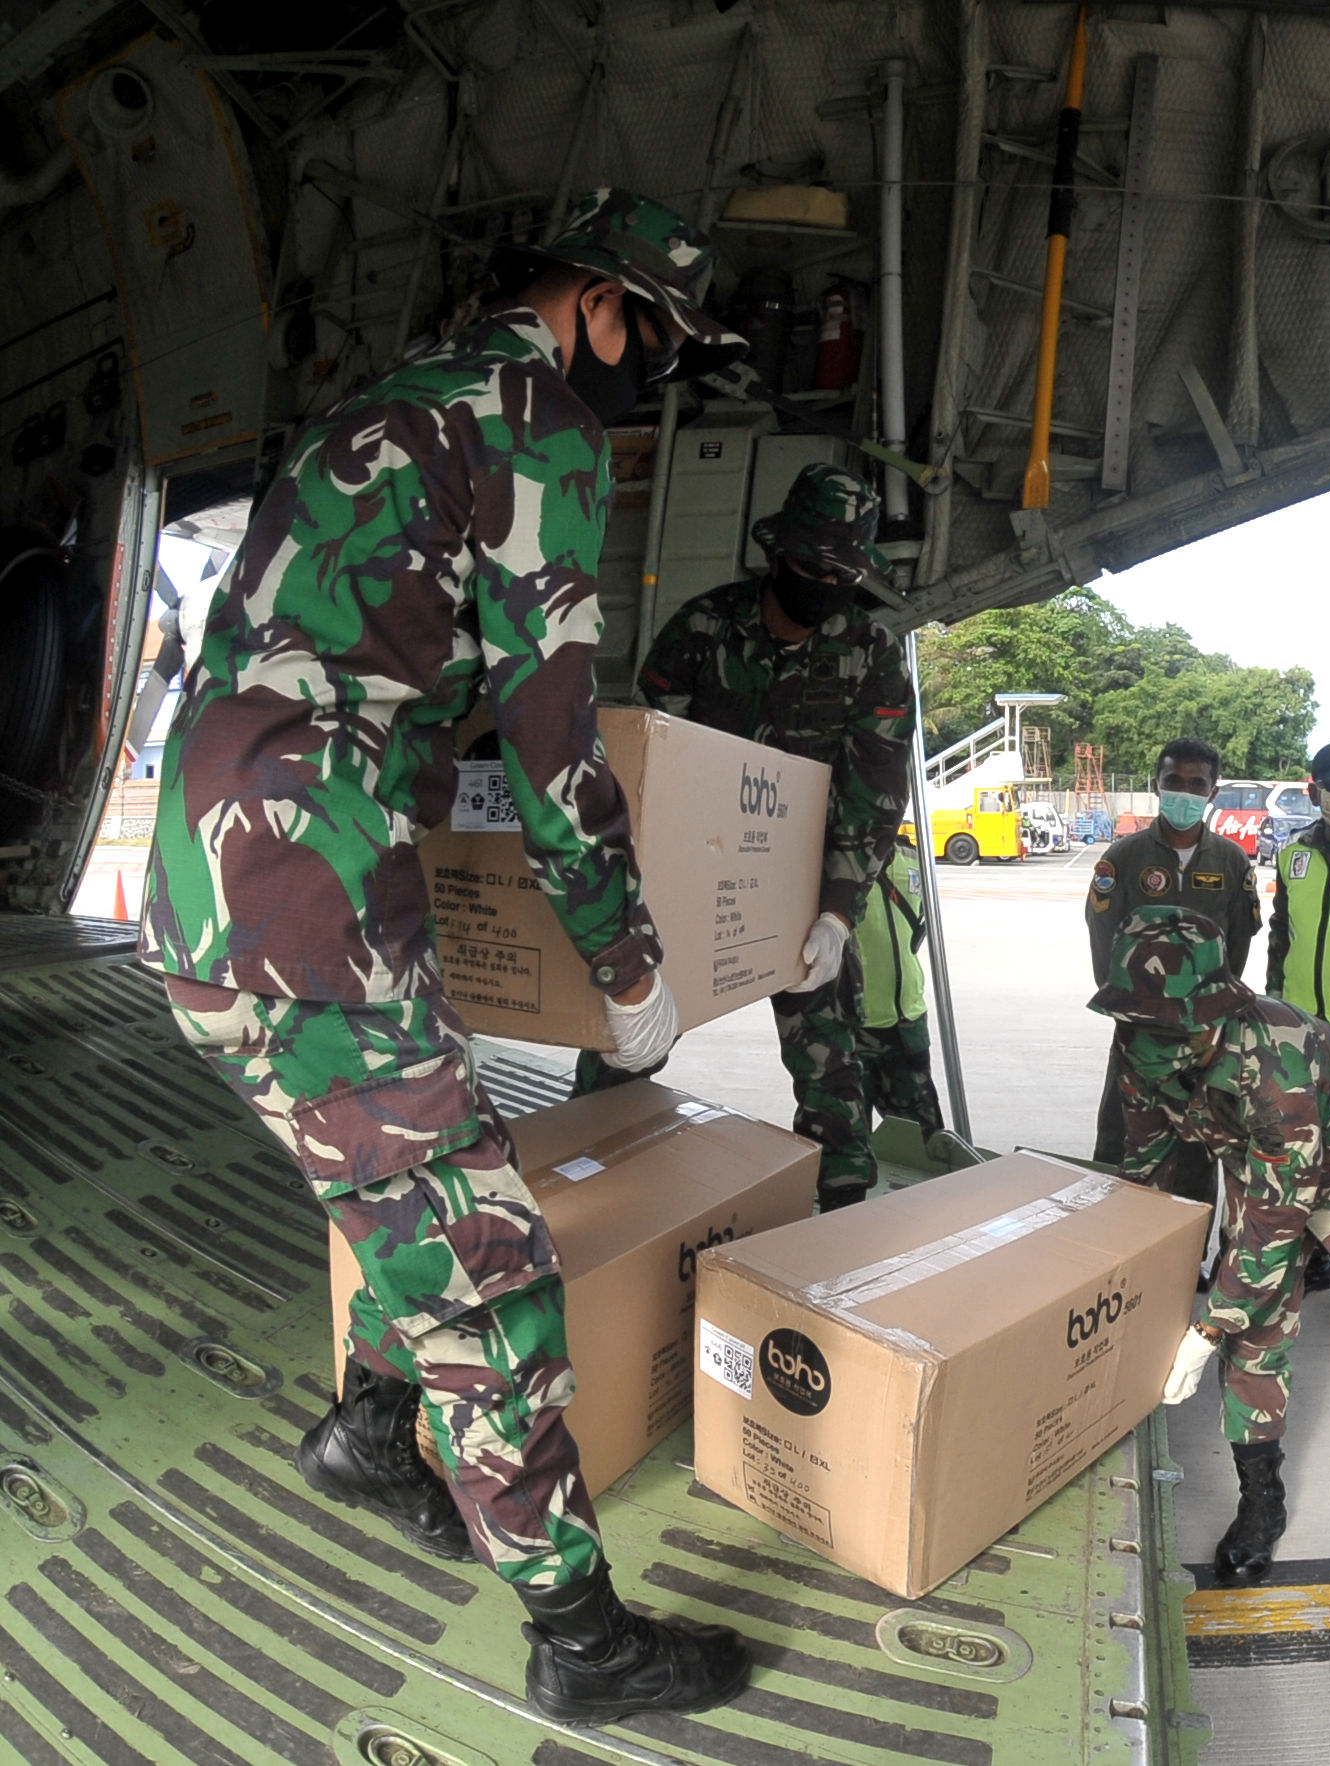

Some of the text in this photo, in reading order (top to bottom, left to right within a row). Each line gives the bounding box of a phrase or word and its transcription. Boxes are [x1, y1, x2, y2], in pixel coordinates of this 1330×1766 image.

[740, 762, 777, 818] boho
[434, 898, 460, 911] Color
[469, 903, 498, 917] White
[448, 884, 480, 898] Pieces
[1067, 1291, 1123, 1349] boho
[768, 1339, 825, 1391] boho
[742, 1437, 764, 1454] Color
[770, 1453, 795, 1473] White
